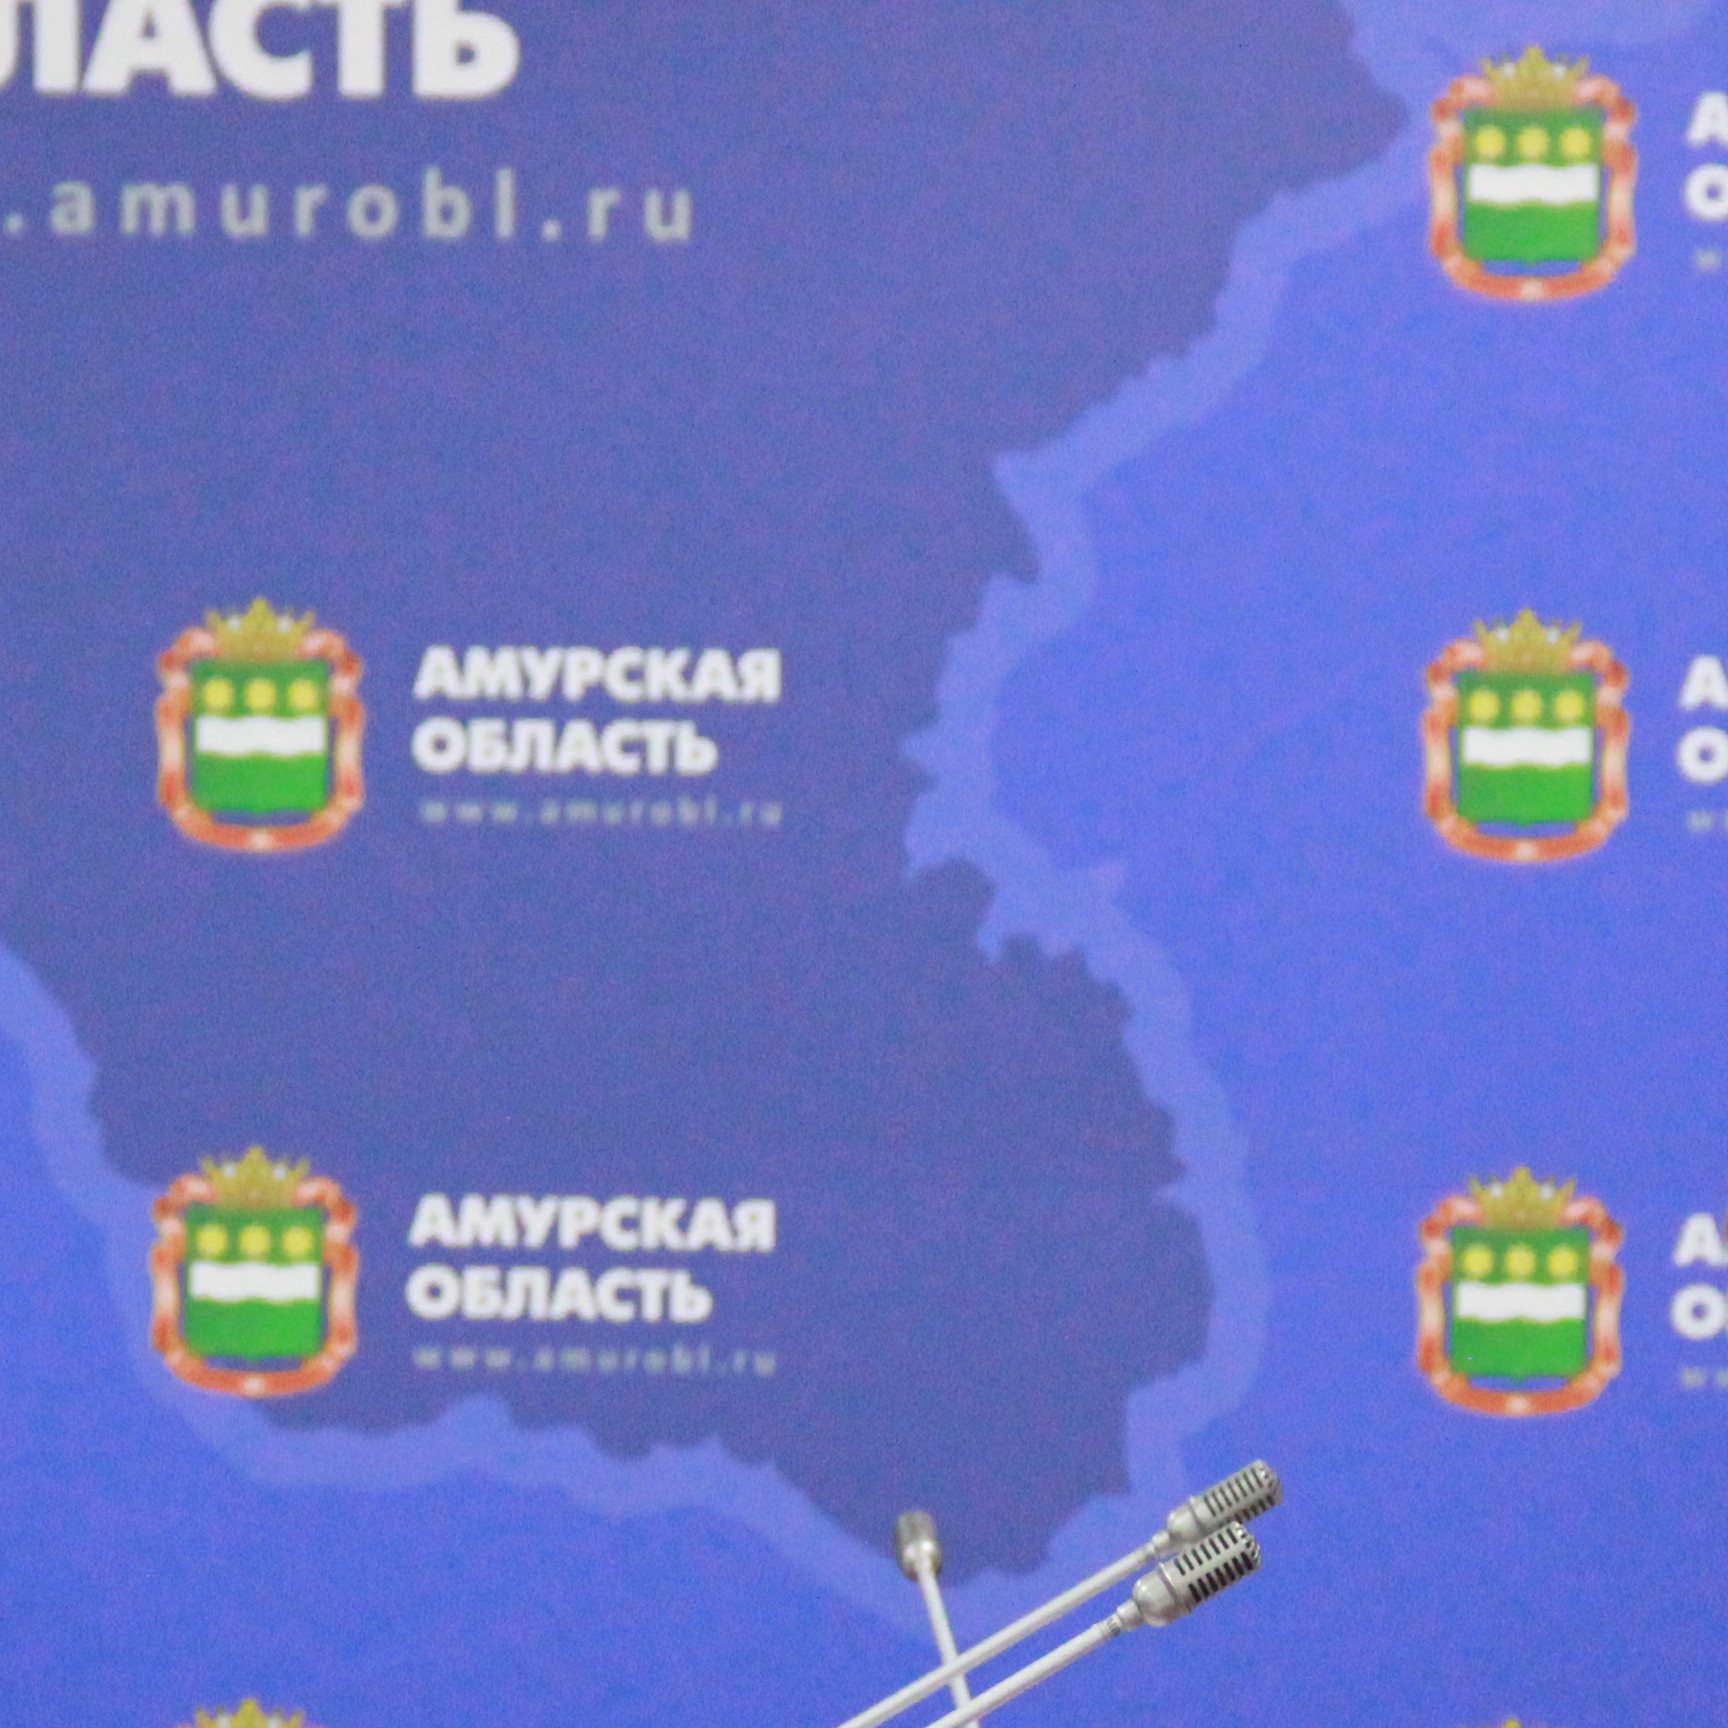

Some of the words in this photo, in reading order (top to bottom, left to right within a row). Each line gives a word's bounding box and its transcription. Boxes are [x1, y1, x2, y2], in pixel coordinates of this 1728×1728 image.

[413, 645, 783, 704] АМУРСКАЯ
[411, 714, 719, 775] ОБЛАСТЬ
[408, 1193, 777, 1253] АМУРСКАЯ
[405, 1263, 714, 1324] ОБЛАСТЬ
